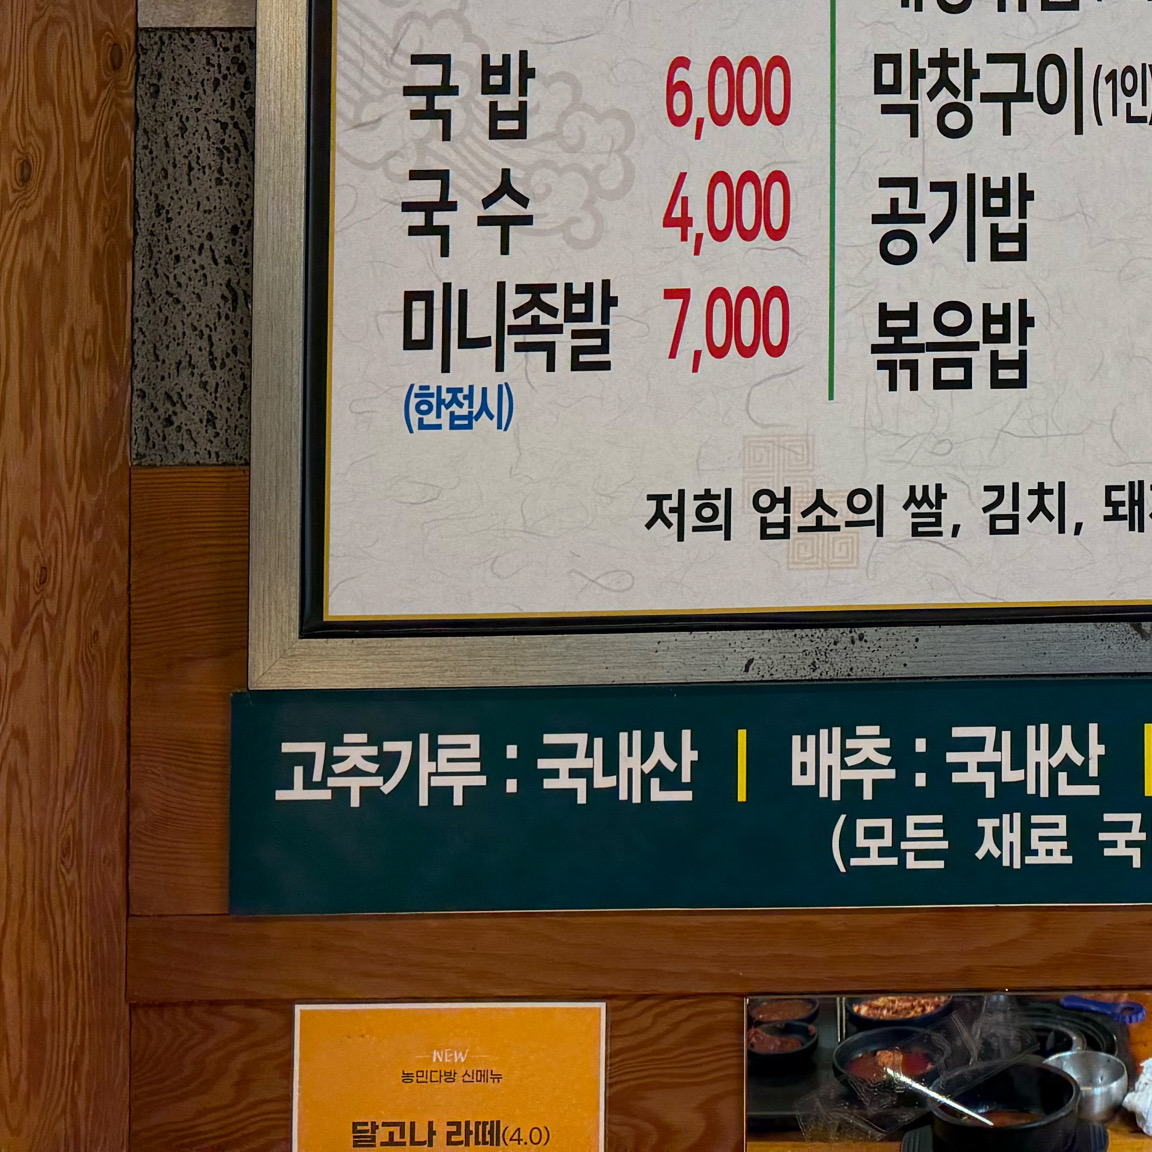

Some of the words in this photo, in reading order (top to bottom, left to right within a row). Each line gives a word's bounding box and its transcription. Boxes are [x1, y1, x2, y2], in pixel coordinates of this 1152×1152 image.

[665, 55, 792, 141] 6,000
[662, 169, 791, 257] 4,000
[871, 172, 1035, 266] 공기밥
[402, 278, 619, 374] 미니족발
[663, 285, 790, 374] 7,000
[870, 298, 1035, 392] 볶음밥
[404, 382, 514, 434] (한접시)
[644, 487, 732, 543] 저희
[752, 484, 885, 541] 업소의
[902, 483, 961, 538] 쌀,
[981, 480, 1084, 536] 김치,
[537, 729, 699, 805] 국내산
[945, 722, 1106, 799] 국내산
[831, 814, 949, 873] (모든
[974, 812, 1073, 869] 재료
[401, 1069, 457, 1084] 농민다방
[461, 1069, 503, 1084] 신메뉴
[432, 1048, 469, 1063] NEW
[351, 1120, 437, 1149] 달고나
